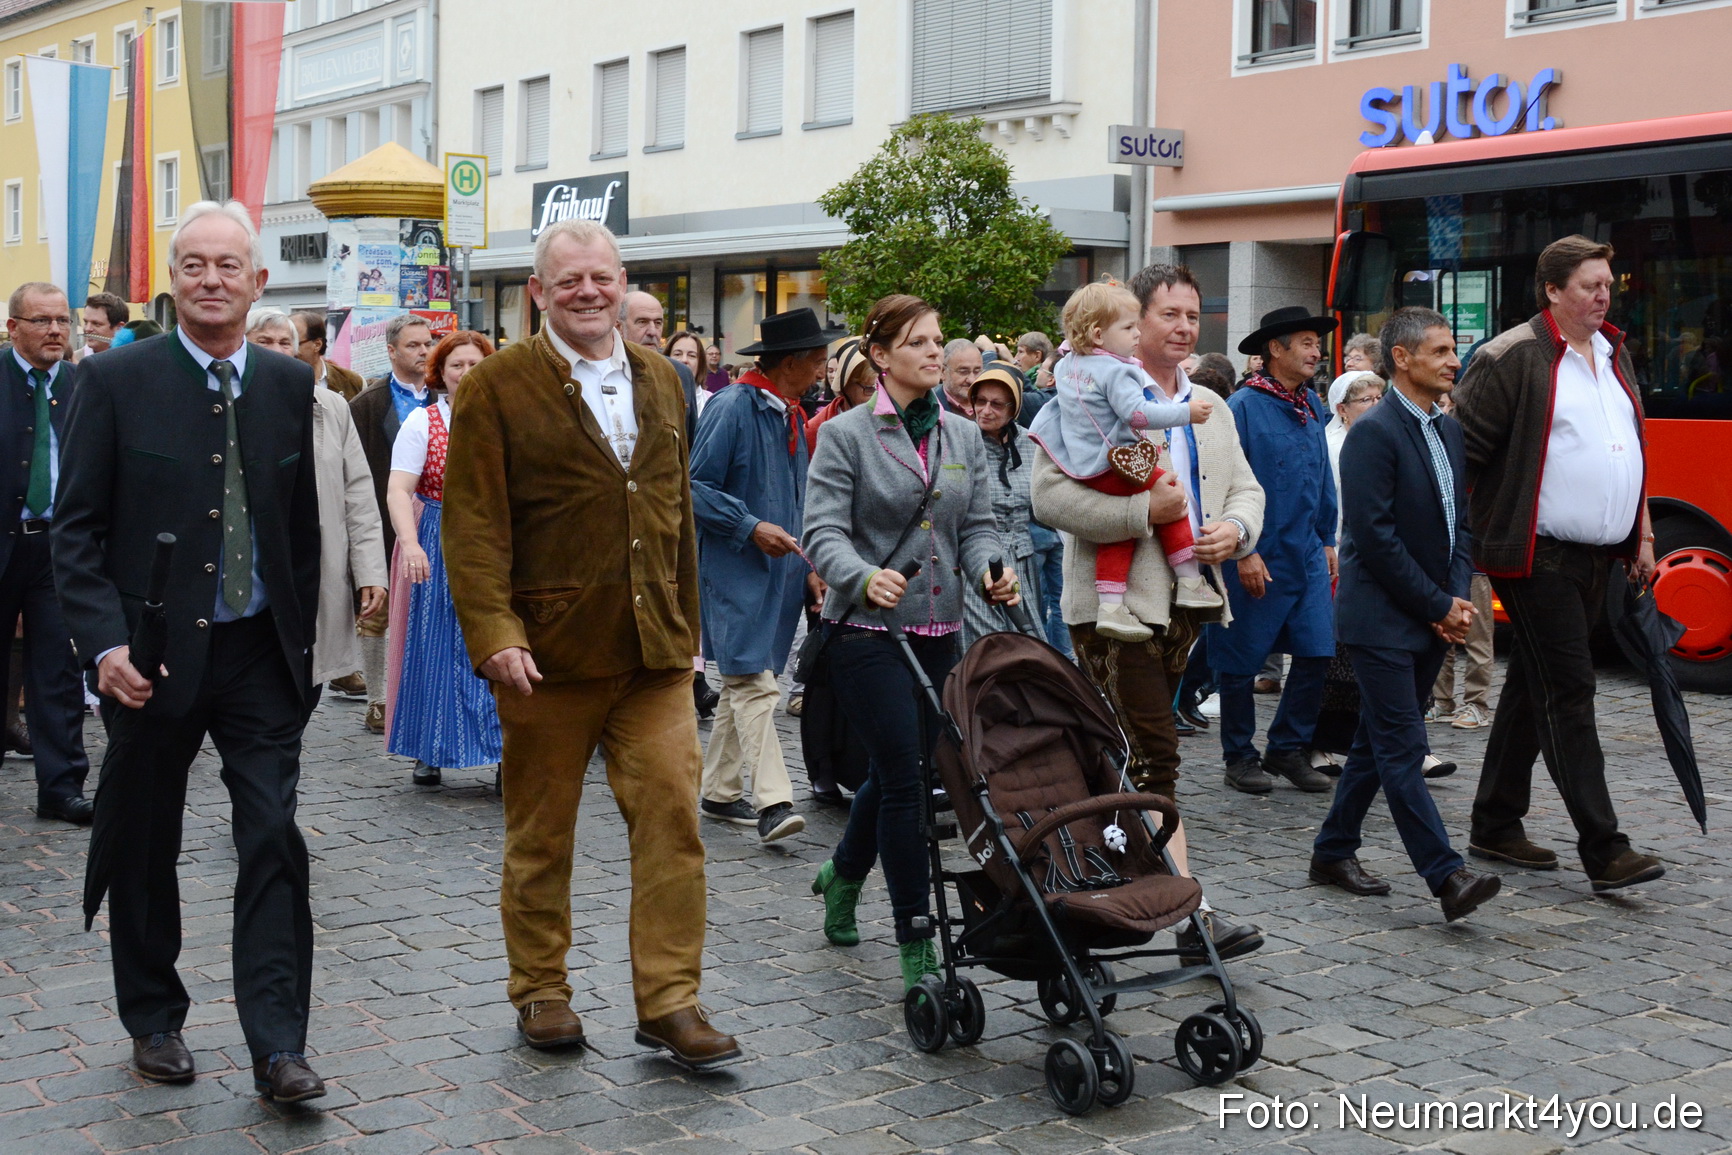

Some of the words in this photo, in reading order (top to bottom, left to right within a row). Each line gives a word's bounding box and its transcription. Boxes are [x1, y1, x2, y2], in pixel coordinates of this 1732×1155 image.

[301, 56, 340, 87] BRILLEN
[342, 46, 380, 76] WEBER
[453, 199, 480, 207] Marktplatz
[532, 181, 621, 235] frühauf
[280, 231, 328, 262] BRILLEN
